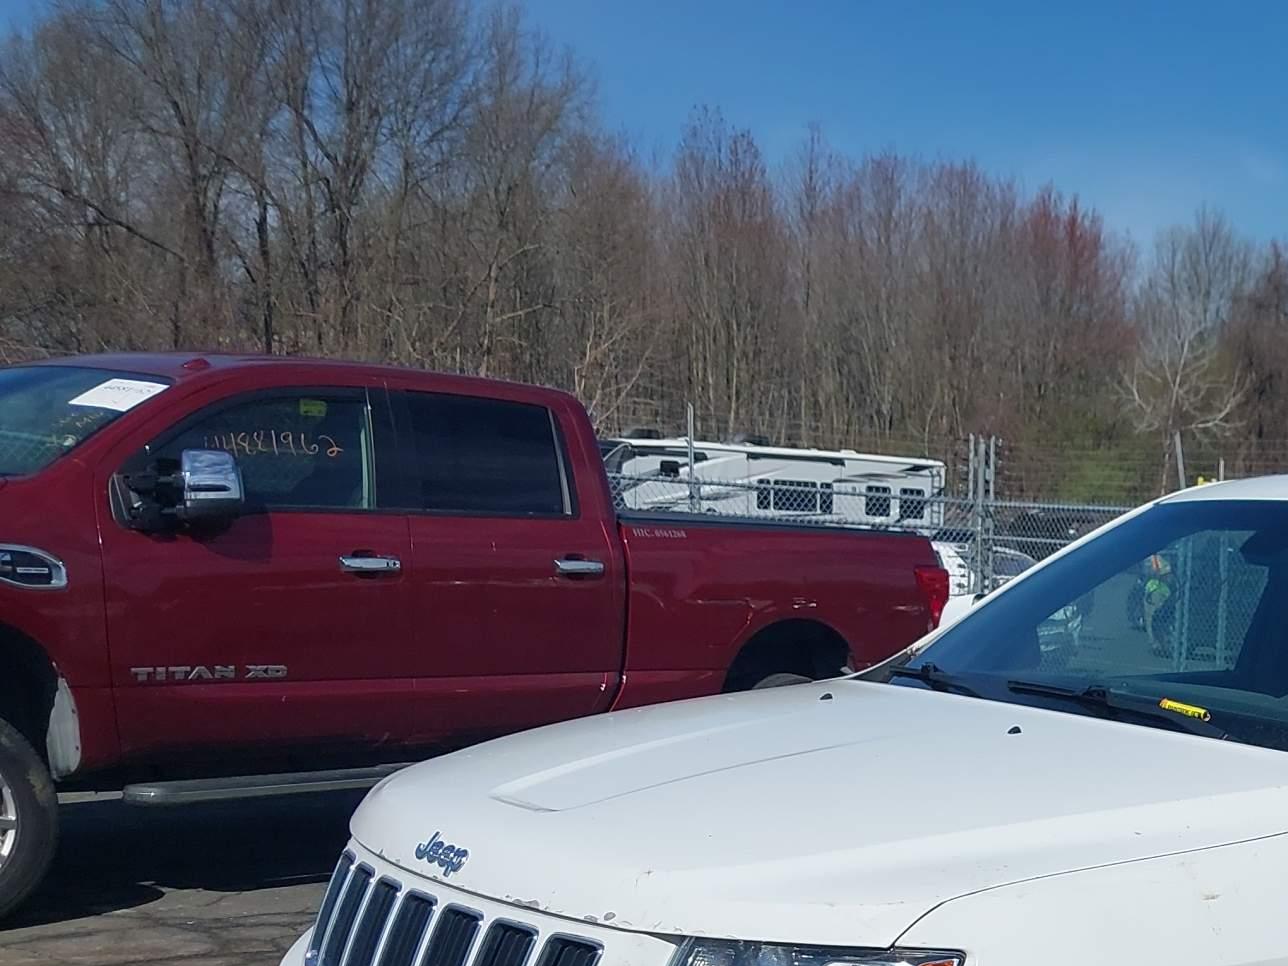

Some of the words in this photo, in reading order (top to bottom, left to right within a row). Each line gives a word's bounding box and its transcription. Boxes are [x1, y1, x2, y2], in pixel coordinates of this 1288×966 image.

[130, 665, 235, 681] TITAN
[244, 664, 288, 679] XD
[415, 831, 469, 877] Jeep
